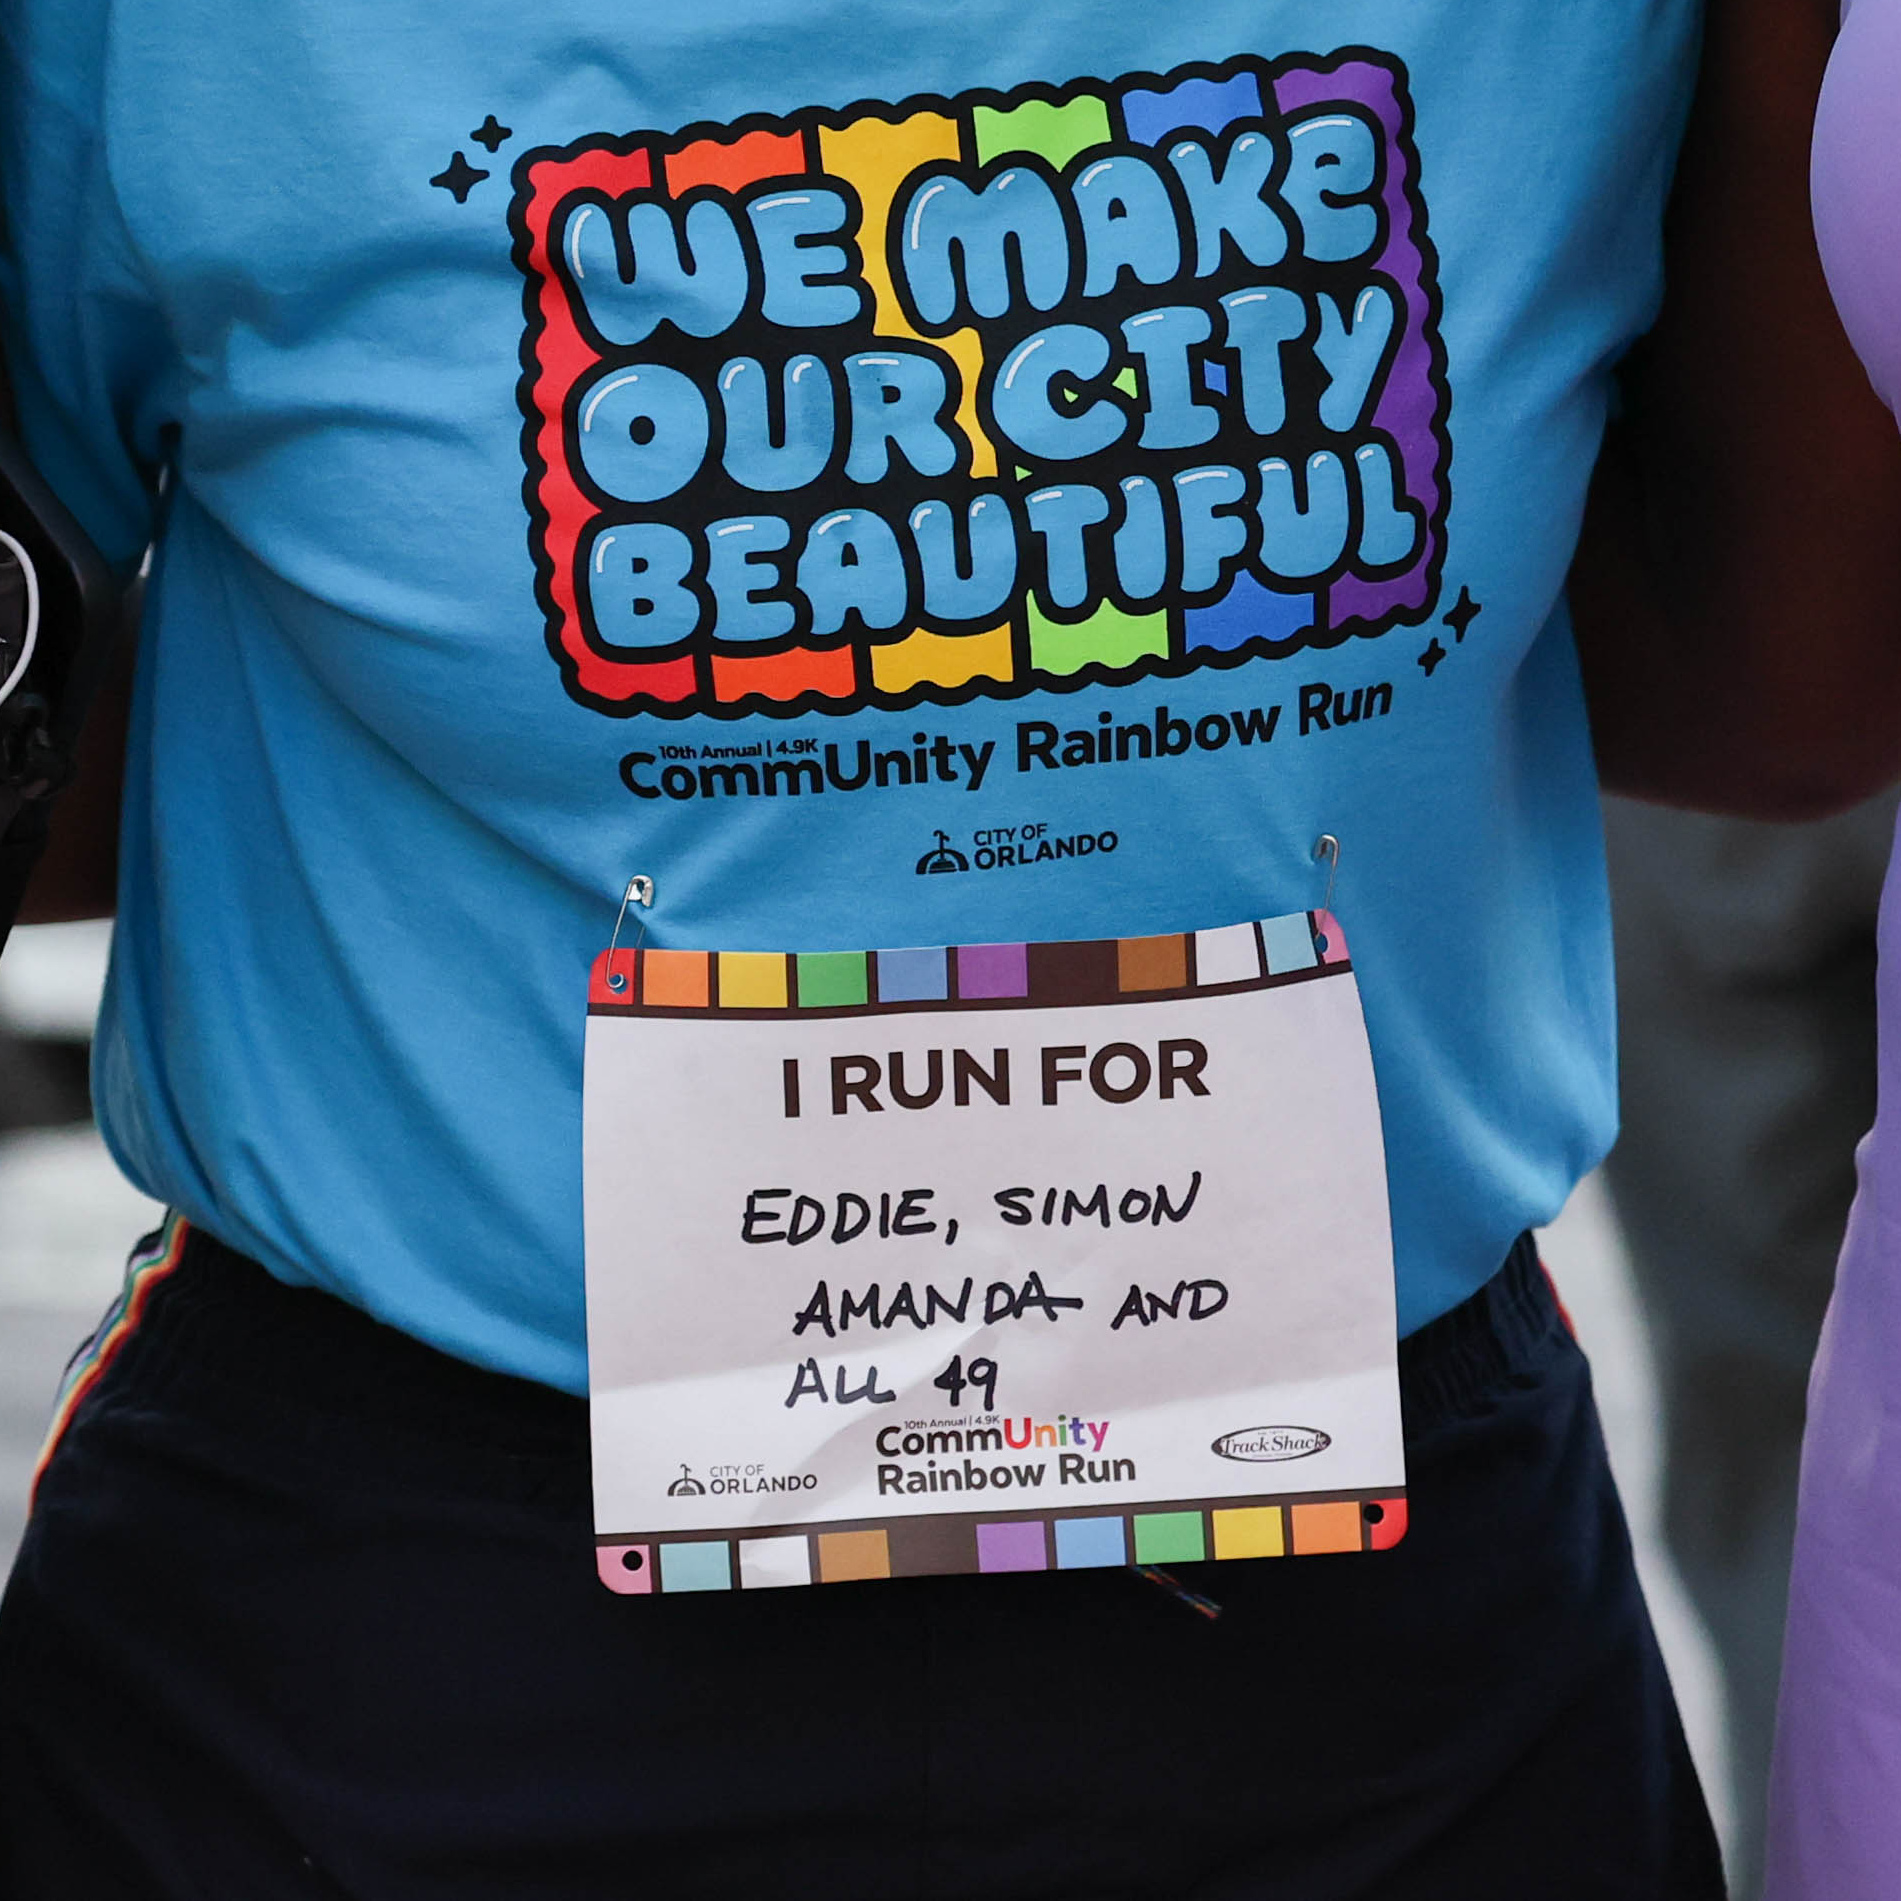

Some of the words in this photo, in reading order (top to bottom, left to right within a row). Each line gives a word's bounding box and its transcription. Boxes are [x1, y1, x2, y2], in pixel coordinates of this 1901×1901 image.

[564, 189, 864, 346] WE
[578, 352, 957, 503] OUR
[992, 285, 1393, 460] CITY
[590, 442, 1420, 648] BEAUTIFUL
[619, 731, 996, 800] CommUnity
[1016, 706, 1282, 773] Rainbow
[1298, 682, 1393, 736] Run
[659, 745, 697, 760] 10th
[700, 741, 762, 759] Annual
[775, 738, 819, 755] 4.9K
[973, 827, 1016, 846] CITY
[1021, 823, 1048, 840] OF
[974, 831, 1118, 870] ORLANDO
[782, 1058, 800, 1118] I
[830, 1047, 1010, 1115] RUN
[1041, 1038, 1211, 1106] FOR
[741, 1188, 959, 1246] EDDIE,
[994, 1171, 1202, 1228] SIMON
[792, 1271, 1084, 1338] AMANDA
[1110, 1279, 1229, 1330] AND
[784, 1357, 897, 1408] ALL
[933, 1354, 997, 1411] 49
[875, 1414, 1109, 1457] CommUnity
[903, 1420, 927, 1430] 10th
[930, 1418, 966, 1428] Annual
[974, 1415, 1000, 1426] 4.9K
[1219, 1436, 1269, 1454] Track
[1271, 1432, 1326, 1452] Shack
[709, 1465, 741, 1478] CITY
[745, 1464, 765, 1476] OF
[710, 1474, 818, 1495] ORLANDO
[877, 1460, 1046, 1495] Rainbow
[1059, 1453, 1136, 1485] Run
